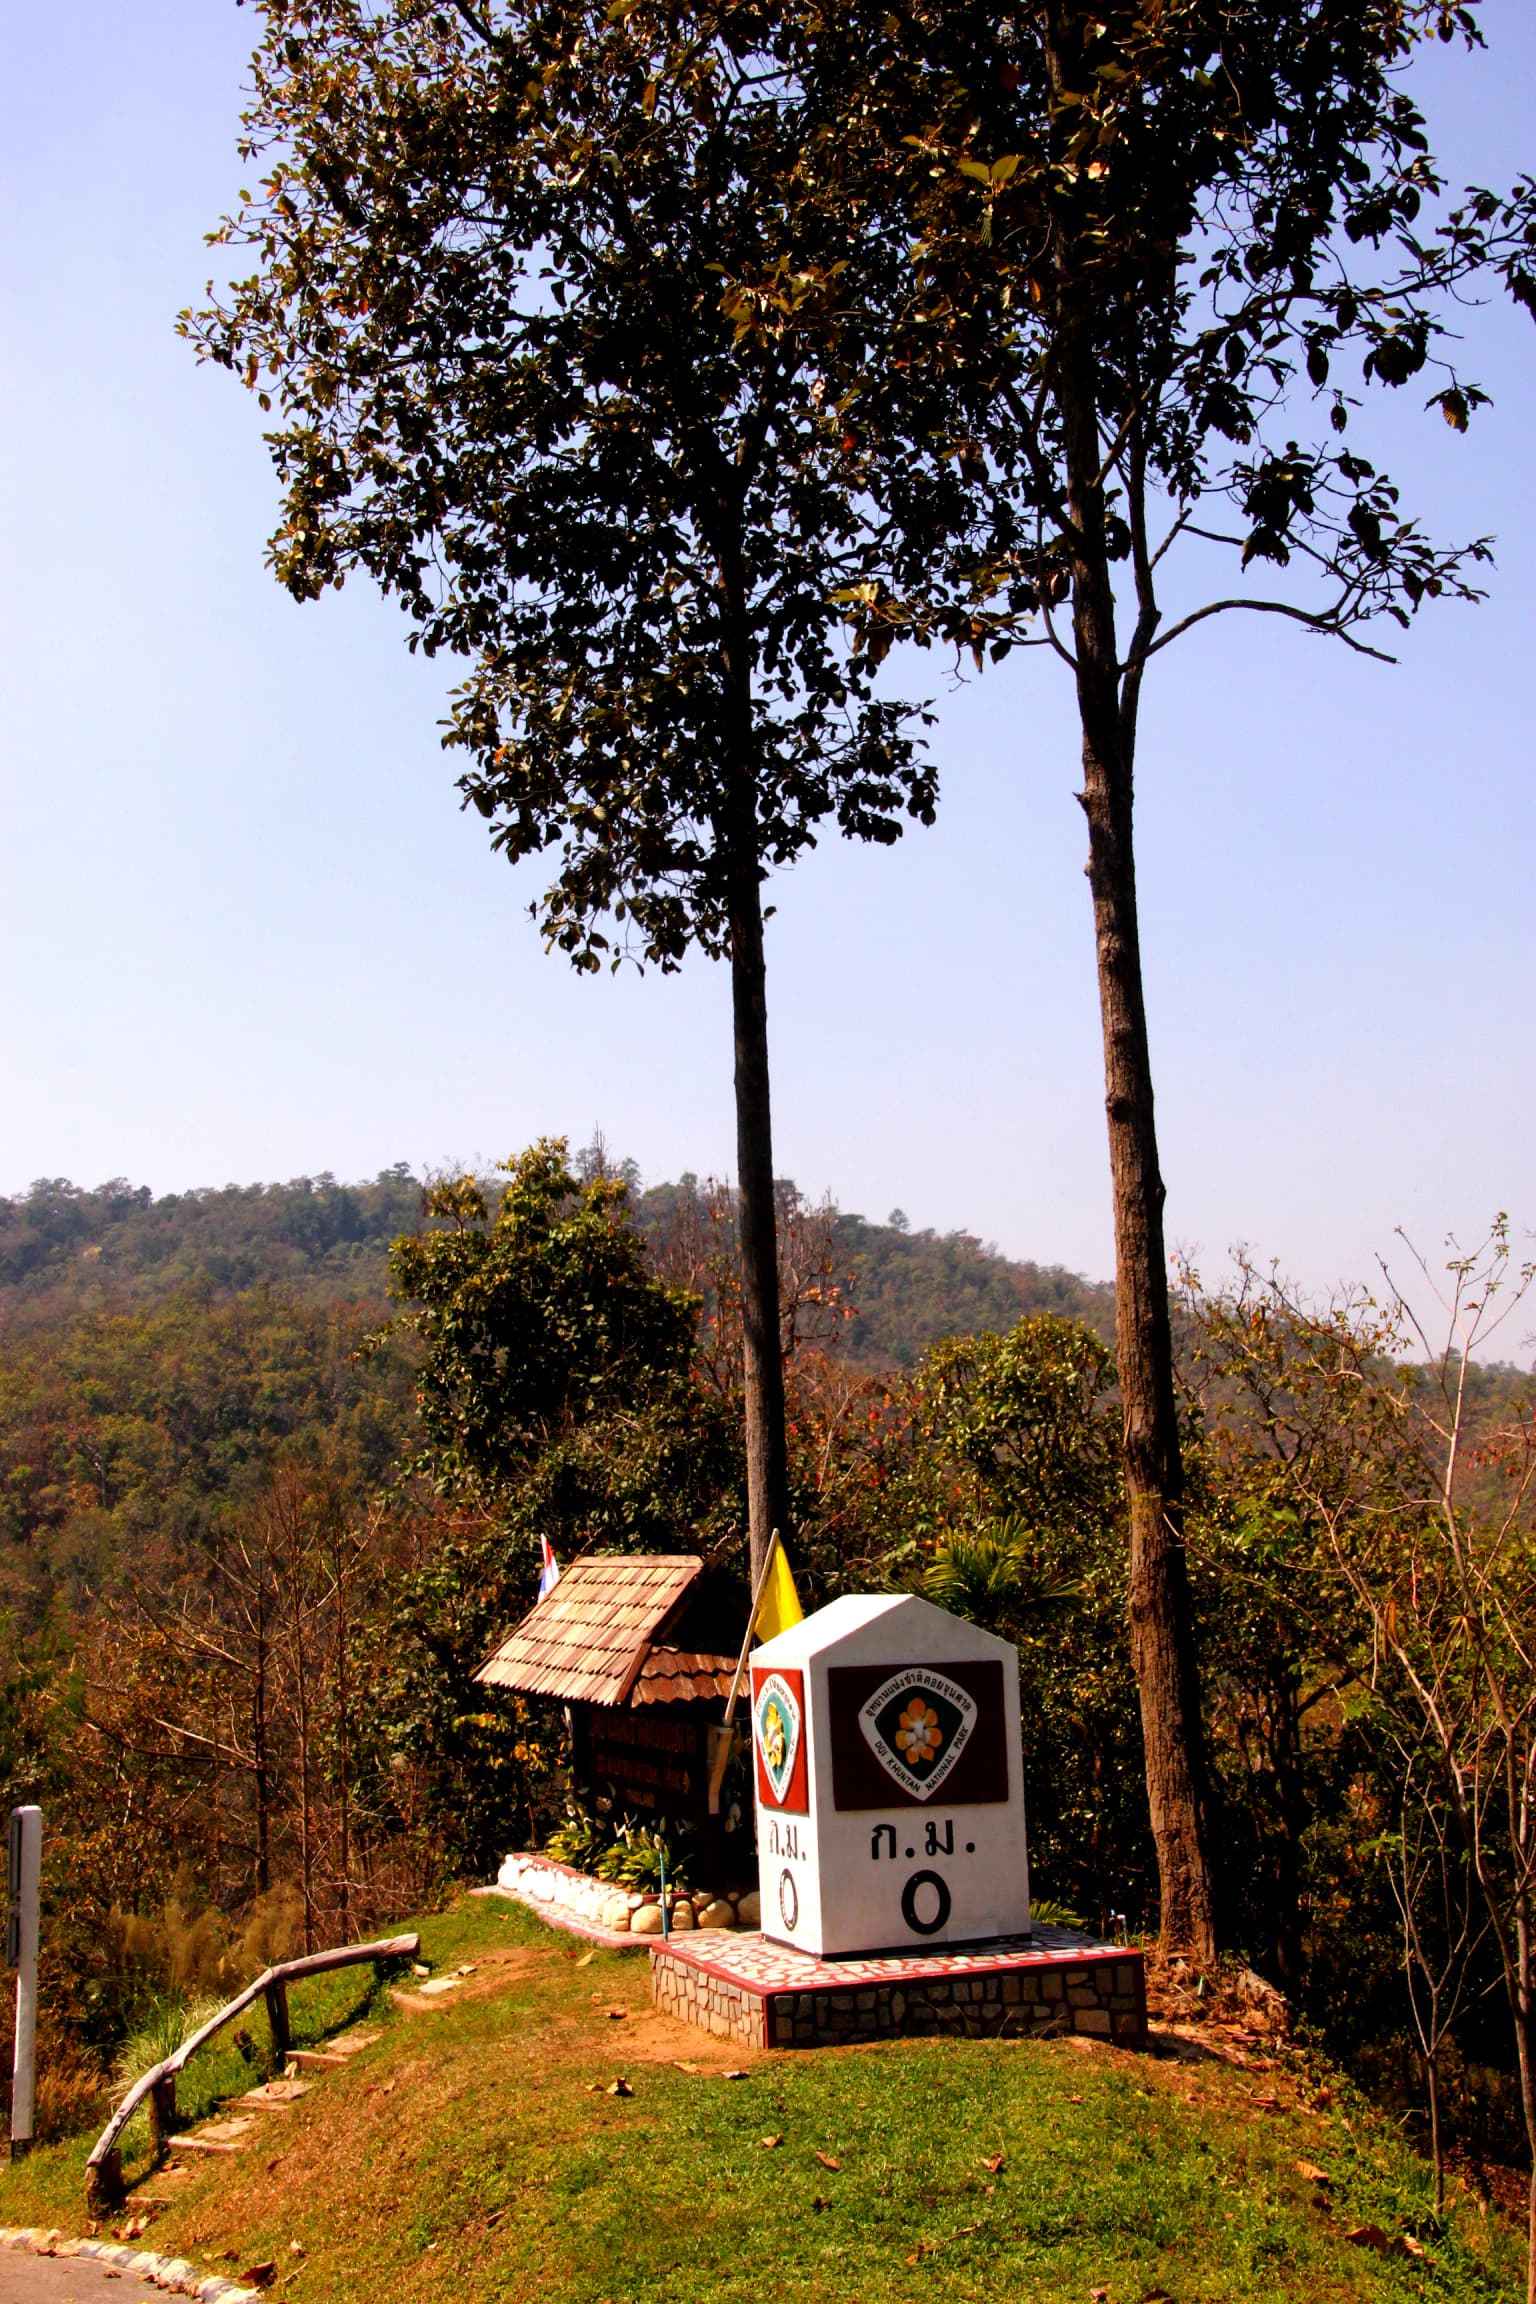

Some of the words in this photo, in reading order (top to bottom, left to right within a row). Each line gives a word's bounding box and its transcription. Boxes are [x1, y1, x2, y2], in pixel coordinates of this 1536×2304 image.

[875, 1740, 889, 1757] DOI
[887, 1758, 921, 1793] KHUNTAN
[925, 1754, 956, 1791] NATIONAL
[953, 1725, 969, 1750] PARK
[871, 1819, 976, 1860] ก.ม.
